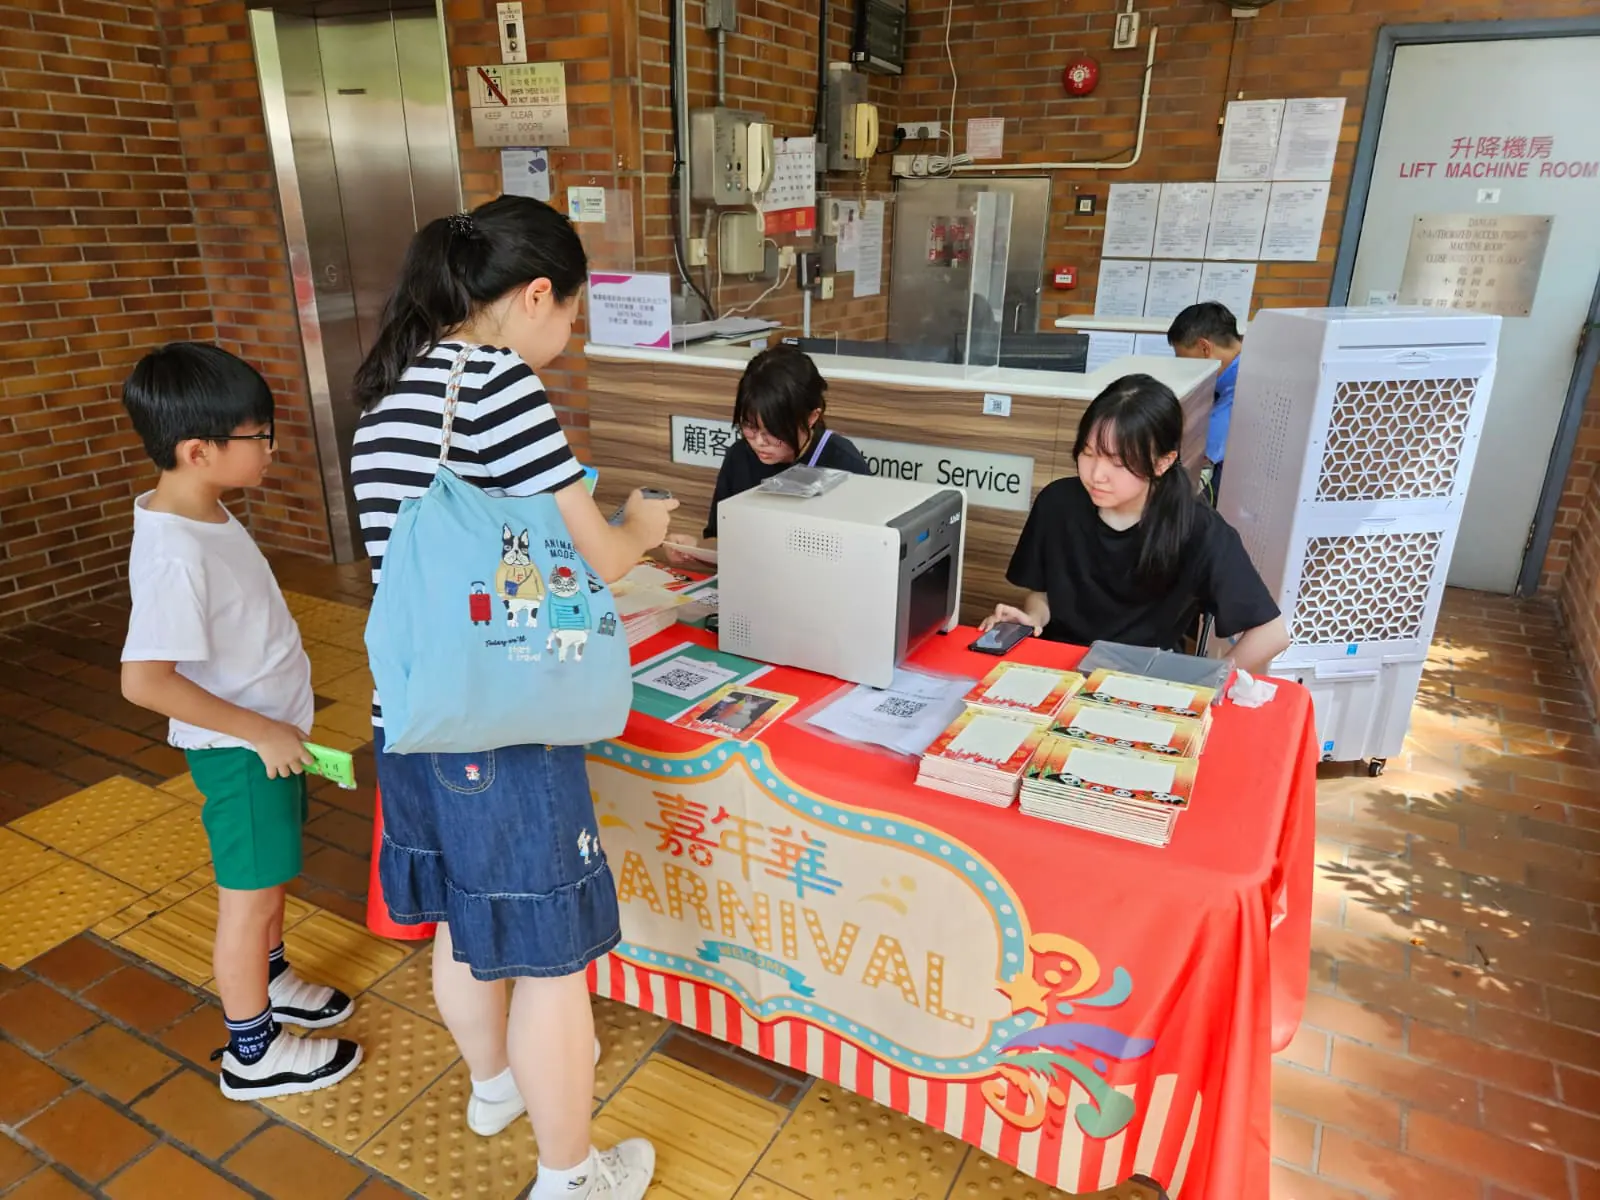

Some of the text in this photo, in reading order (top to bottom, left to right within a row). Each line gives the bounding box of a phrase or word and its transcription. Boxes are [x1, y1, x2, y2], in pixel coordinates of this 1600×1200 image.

[511, 110, 533, 120] CLEAR
[1450, 136, 1554, 159] 升降機房
[1400, 162, 1599, 178] LIFT MACHINE ROOM
[682, 424, 742, 456] 顧客
[860, 450, 1020, 494] tomer Service
[550, 550, 575, 560] MODE
[645, 790, 842, 899] 嘉年華
[618, 849, 975, 1030] ARNIVAL
[719, 946, 788, 976] WELCOME
